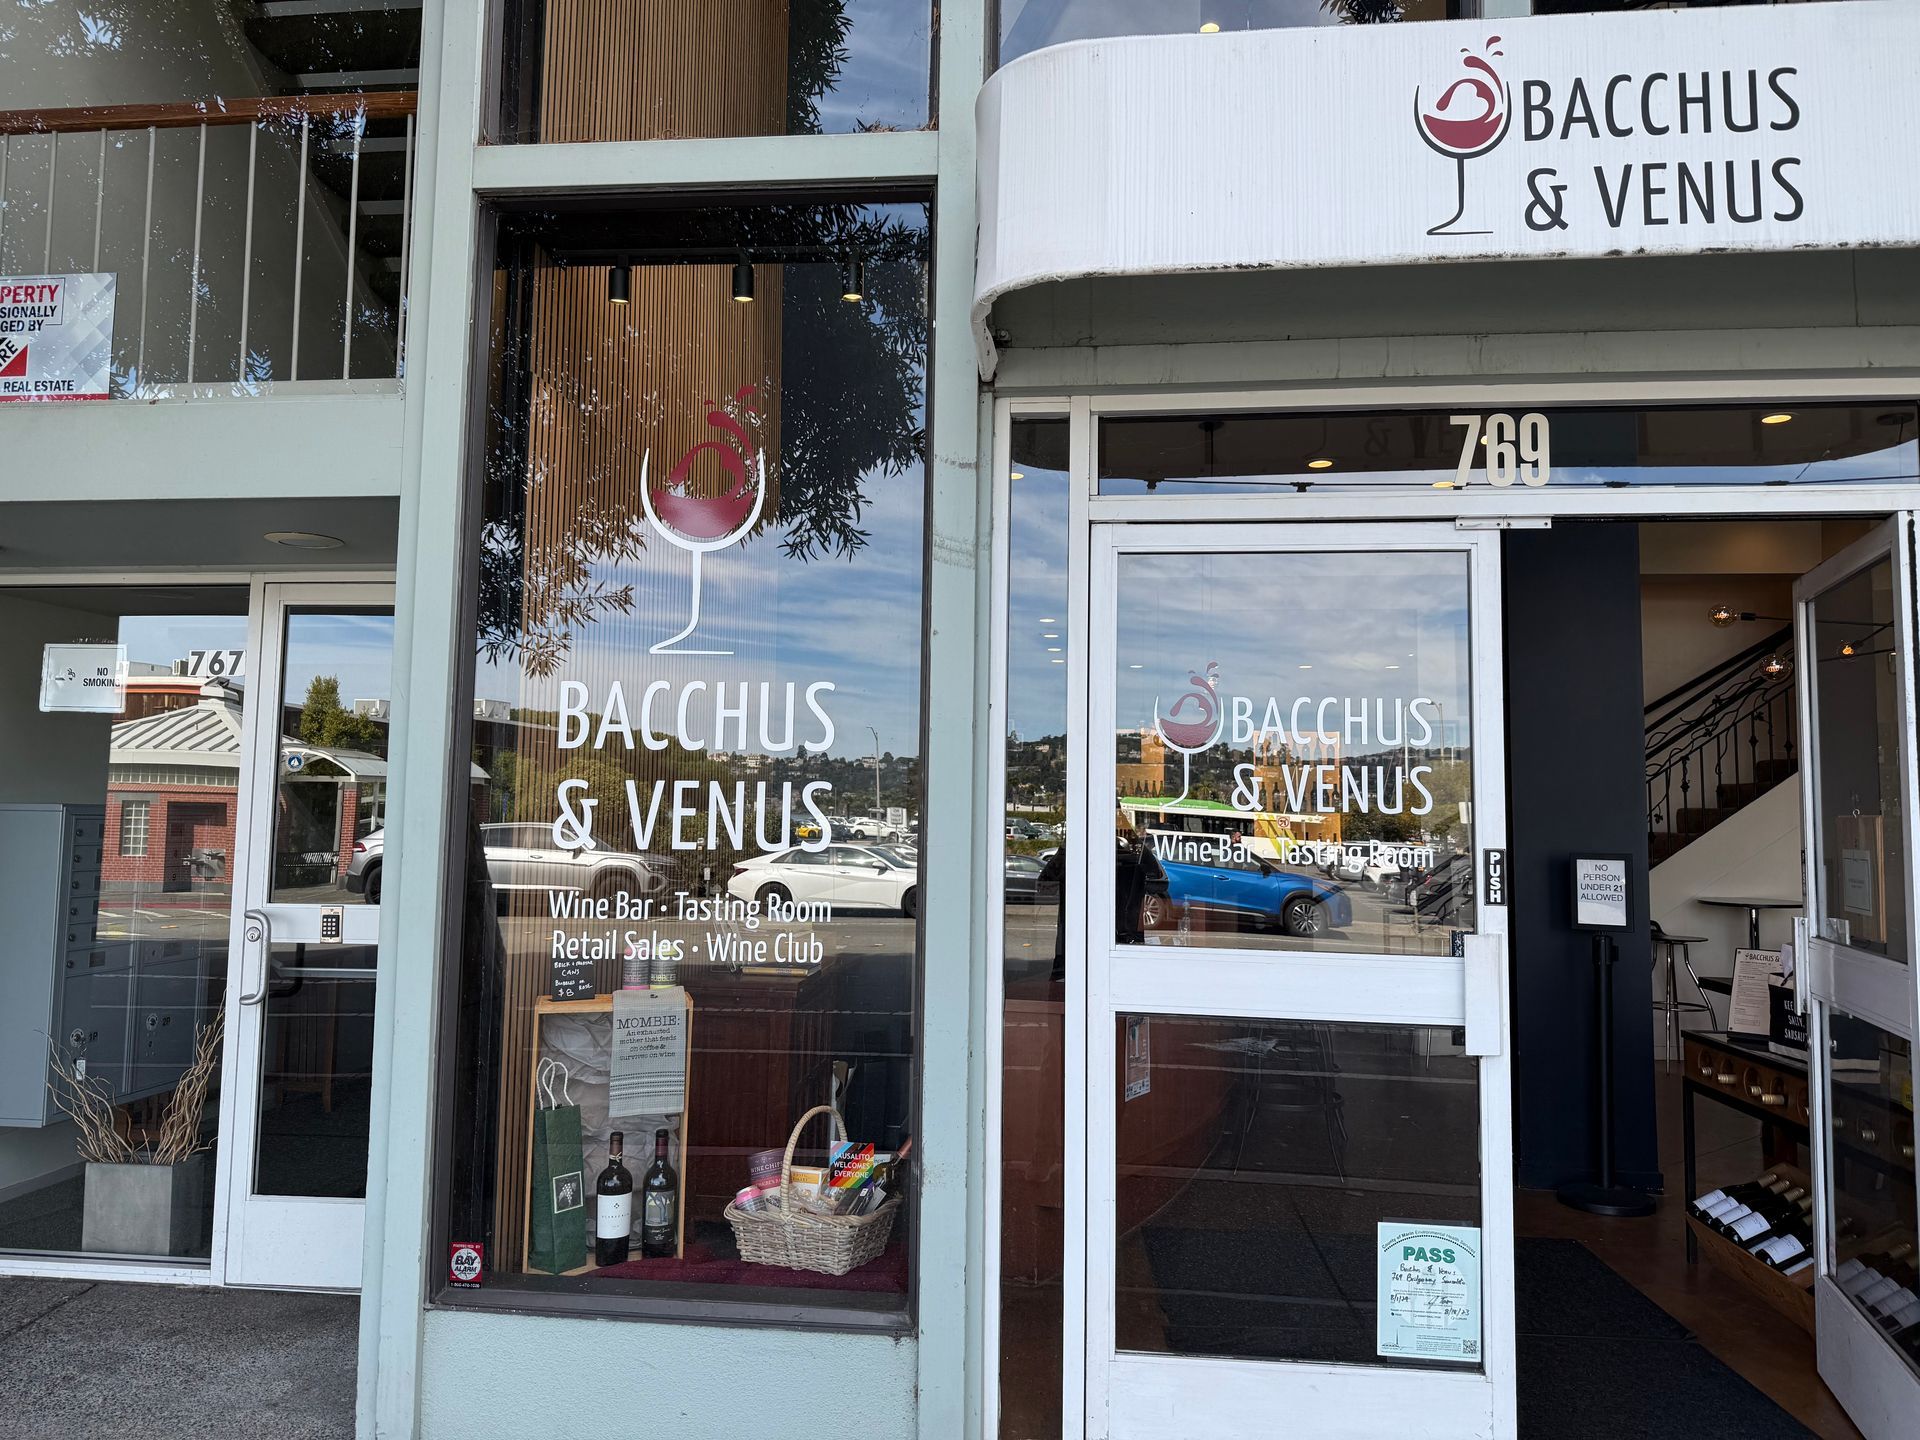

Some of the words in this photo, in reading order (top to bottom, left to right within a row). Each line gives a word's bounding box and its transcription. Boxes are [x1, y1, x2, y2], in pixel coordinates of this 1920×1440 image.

[1522, 67, 1801, 141] BACCHUS
[1524, 167, 1569, 231] &
[1593, 157, 1804, 228] VENUS
[28, 319, 44, 332] BY
[4, 381, 31, 393] REAL
[34, 379, 74, 392] ESTATE
[1449, 412, 1550, 487] 769
[189, 650, 245, 676] 767
[96, 667, 109, 677] NO
[82, 678, 121, 688] SMOKING
[557, 680, 836, 752] BACCHUS
[1232, 696, 1433, 747] BACCHUS
[1230, 763, 1264, 812] &
[1282, 765, 1434, 815] VENUS
[552, 779, 599, 850] &
[625, 780, 833, 852] VENUS
[1153, 835, 1212, 863] Wine
[1219, 836, 1254, 863] Bar
[1277, 837, 1361, 873] Tasting
[1369, 839, 1434, 868] Room
[1594, 864, 1609, 872] NO
[1489, 851, 1501, 903] PUSH
[1583, 873, 1621, 882] PERSON
[1580, 883, 1612, 892] UNDER
[1613, 884, 1624, 892] 21
[1580, 893, 1624, 902] ALLOWED
[548, 890, 609, 920] Wine
[615, 890, 653, 920] Bar
[674, 891, 761, 929] Tasting
[767, 893, 832, 923] Room
[552, 929, 616, 960] Retail
[623, 930, 685, 962] Sales
[706, 932, 767, 963] Wine
[774, 933, 824, 964] Club
[561, 969, 580, 977] CANS
[617, 1015, 680, 1029] MOMBIE:
[833, 1161, 871, 1170] WELCOMES
[834, 1170, 870, 1179] EVERYONE
[455, 1255, 478, 1266] BAY
[1403, 1246, 1456, 1263] PASS
